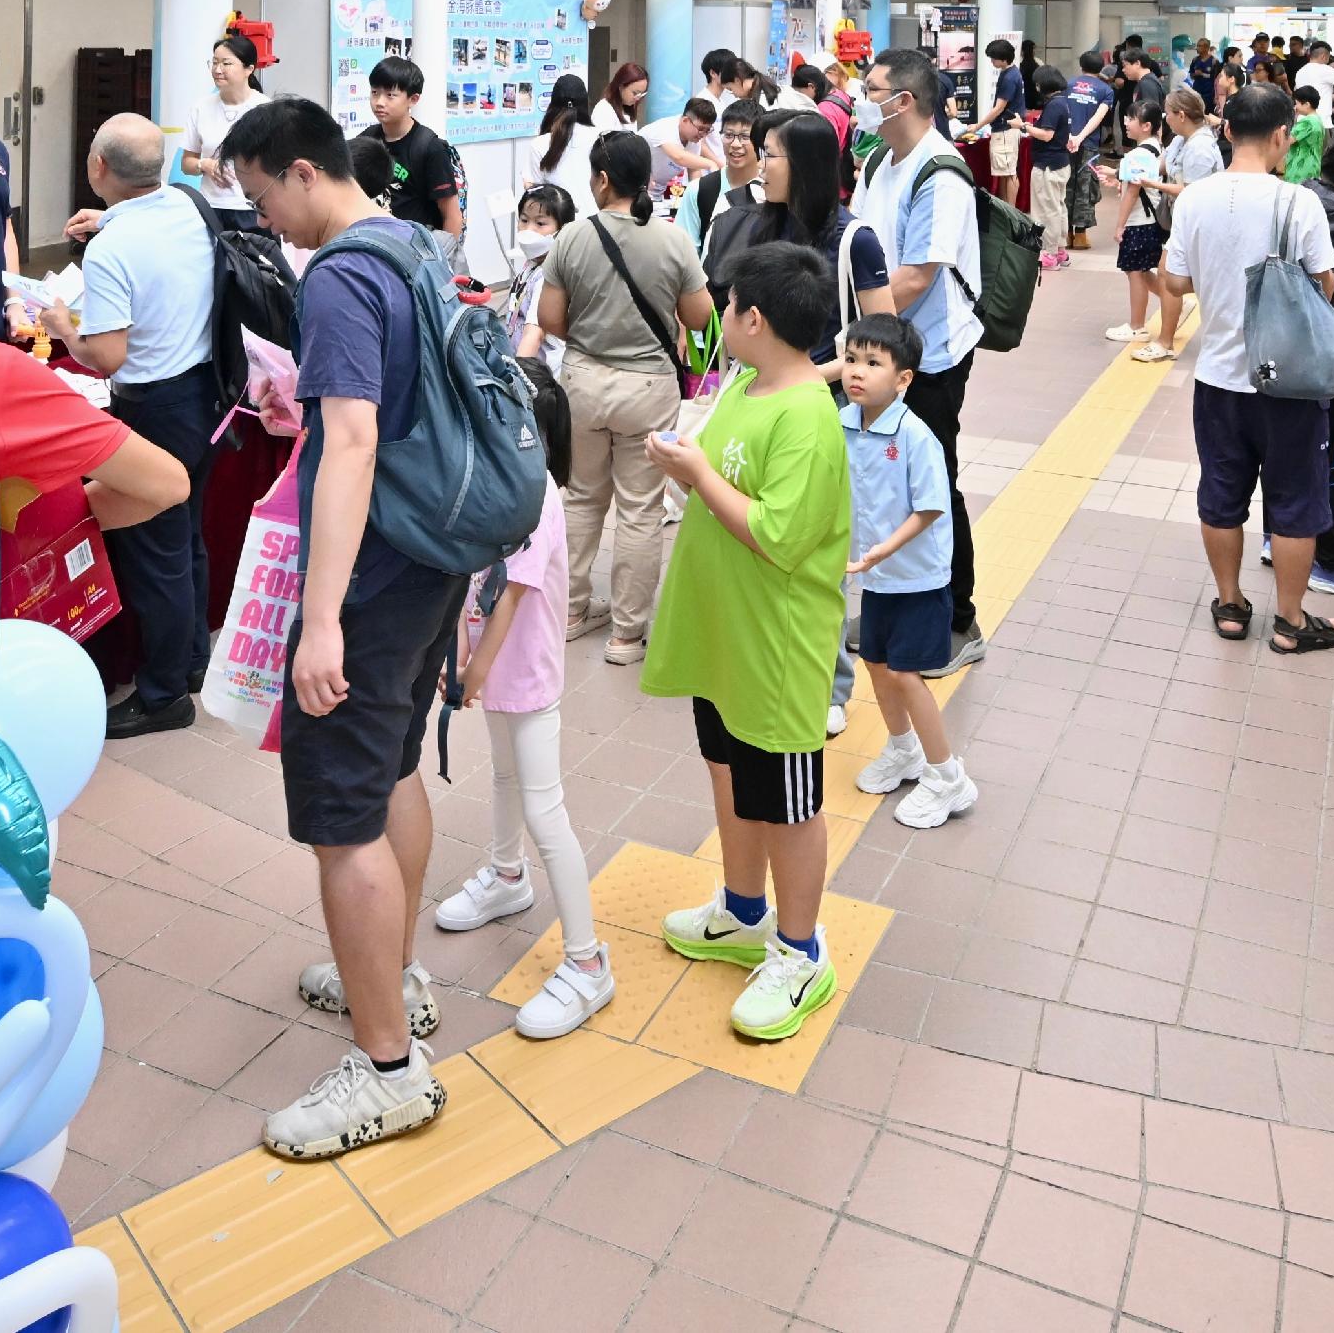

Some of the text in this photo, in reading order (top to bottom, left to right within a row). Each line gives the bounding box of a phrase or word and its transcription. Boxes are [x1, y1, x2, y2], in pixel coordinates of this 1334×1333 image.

[250, 564, 300, 602] FOR
[239, 598, 287, 637] ALL
[227, 632, 288, 673] DAY
